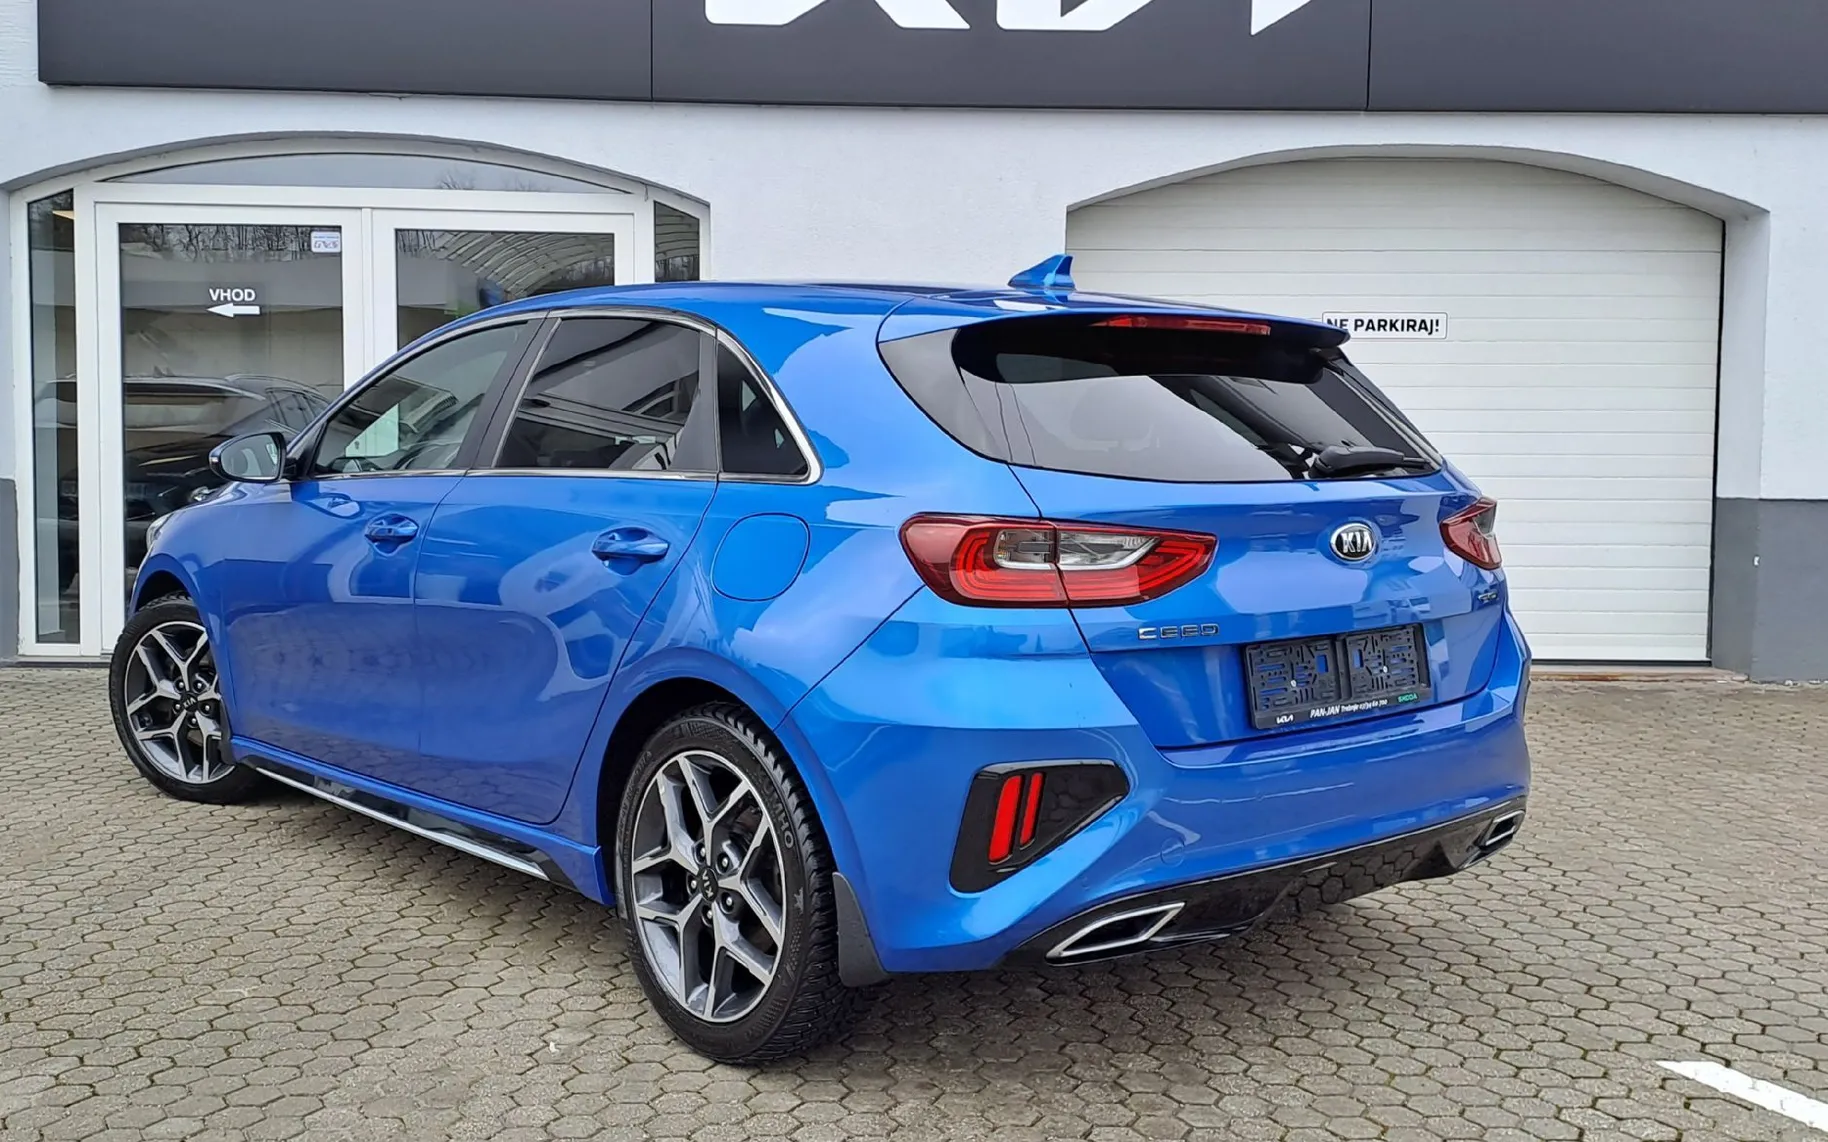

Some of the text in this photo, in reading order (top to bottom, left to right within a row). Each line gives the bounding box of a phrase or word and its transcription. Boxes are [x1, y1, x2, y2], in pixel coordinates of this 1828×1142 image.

[209, 288, 256, 301] VHOD
[1354, 318, 1440, 335] PARKIRAJ!
[1340, 531, 1373, 553] KIA
[1138, 623, 1220, 640] CEED
[1309, 704, 1340, 718] PAN-JAN
